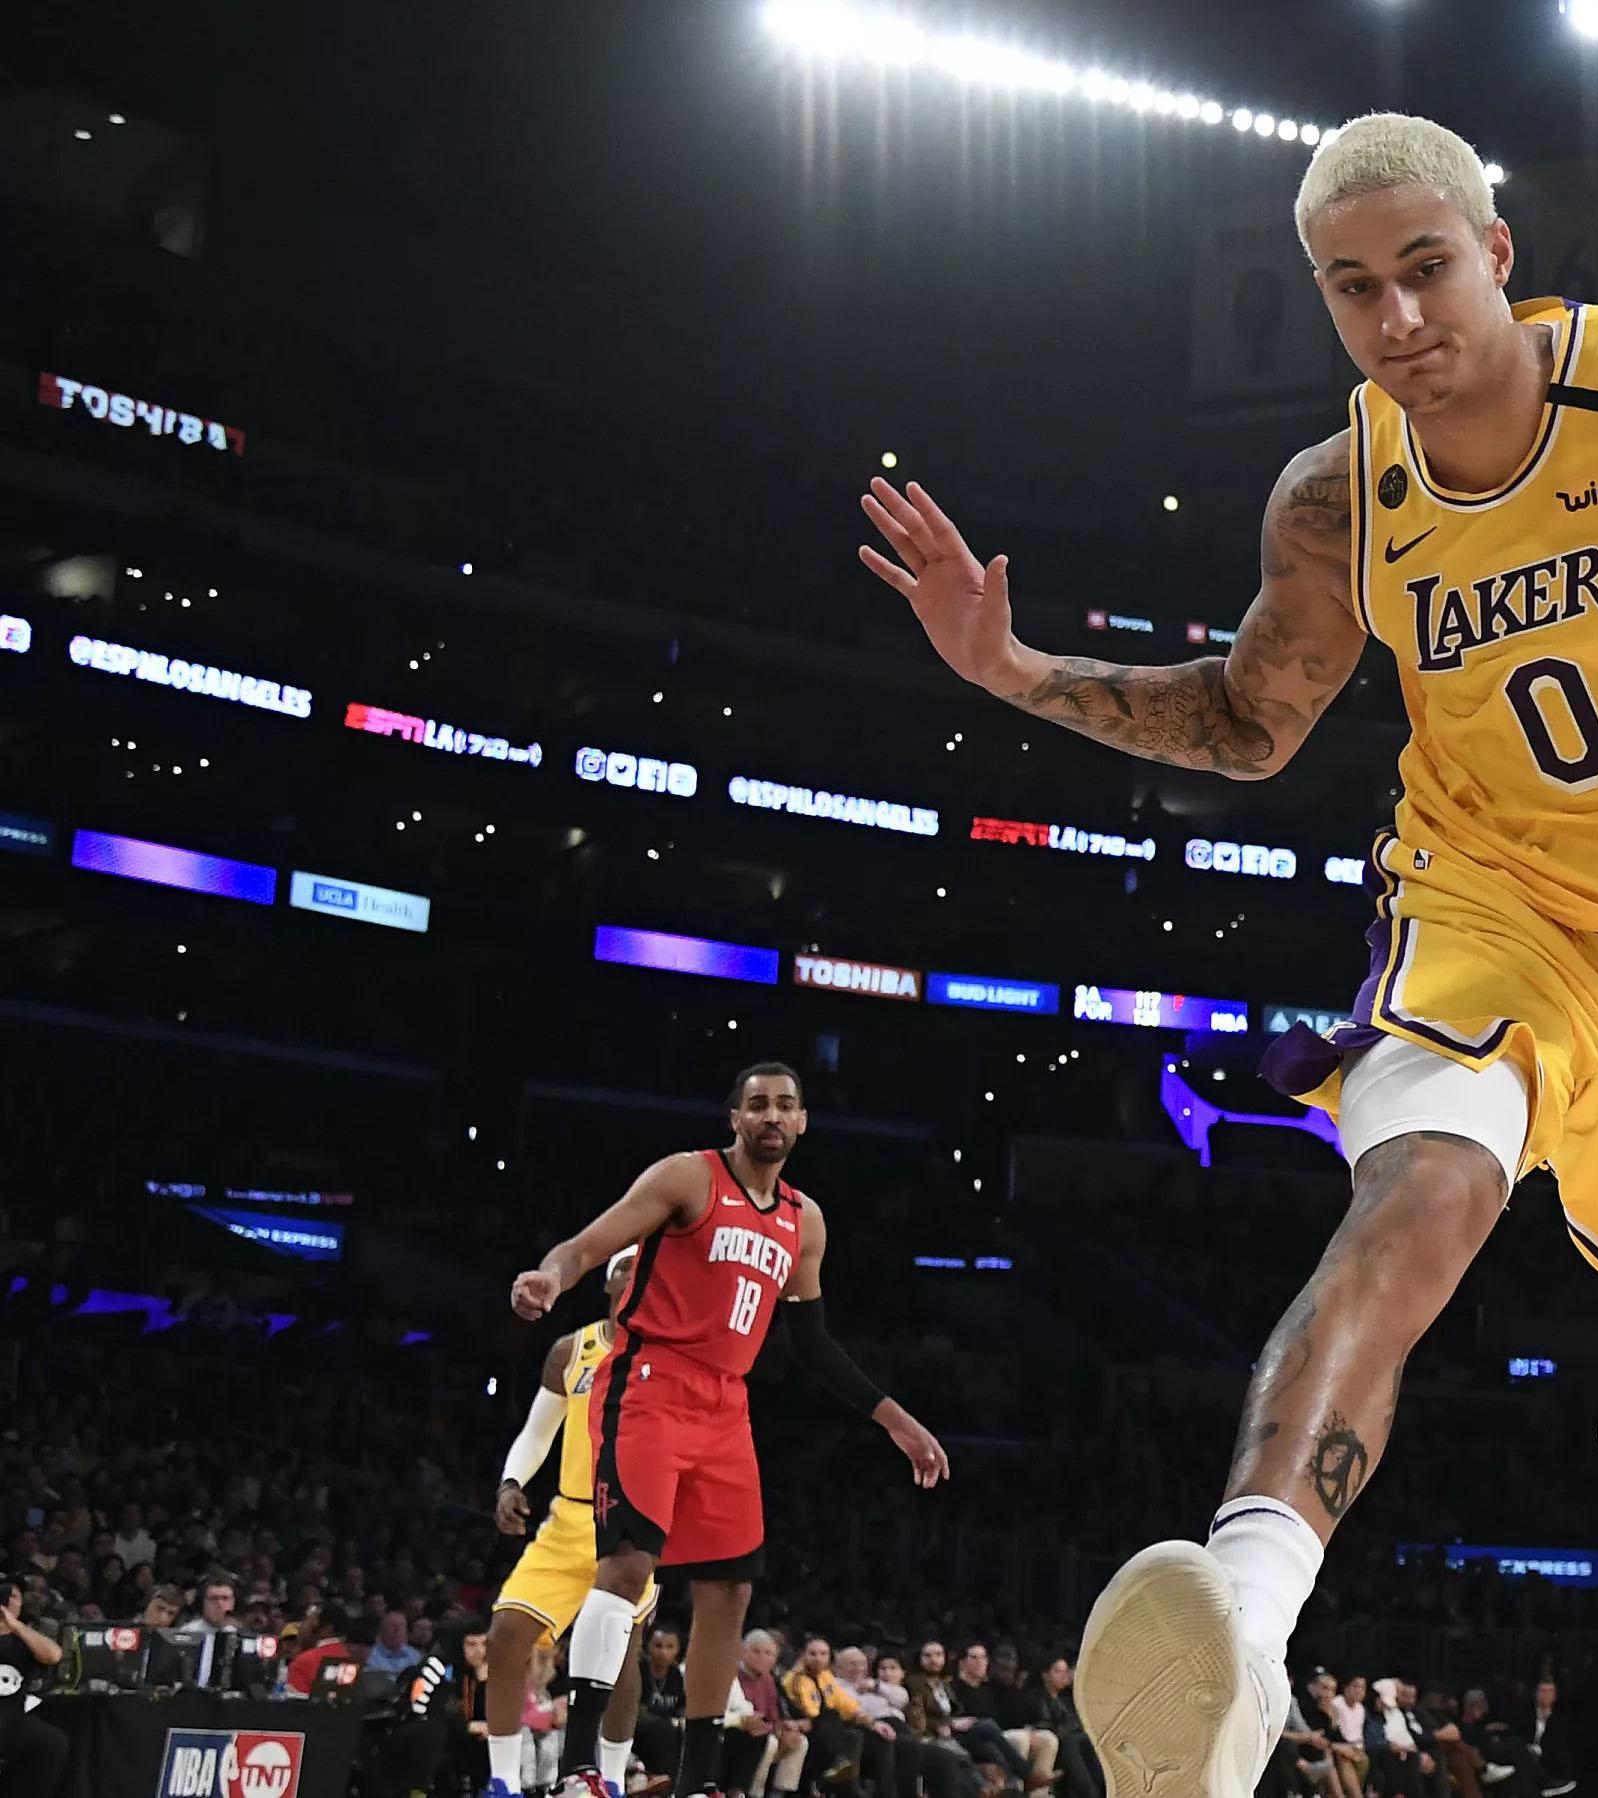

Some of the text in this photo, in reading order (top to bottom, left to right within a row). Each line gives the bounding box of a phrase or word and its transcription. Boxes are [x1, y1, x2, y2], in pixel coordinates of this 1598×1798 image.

[55, 375, 228, 451] TOSHIBA
[795, 957, 919, 999] TOSHIBA
[708, 1225, 793, 1291] ROCKETS
[728, 1275, 762, 1336] 18
[167, 1746, 218, 1797] NBA
